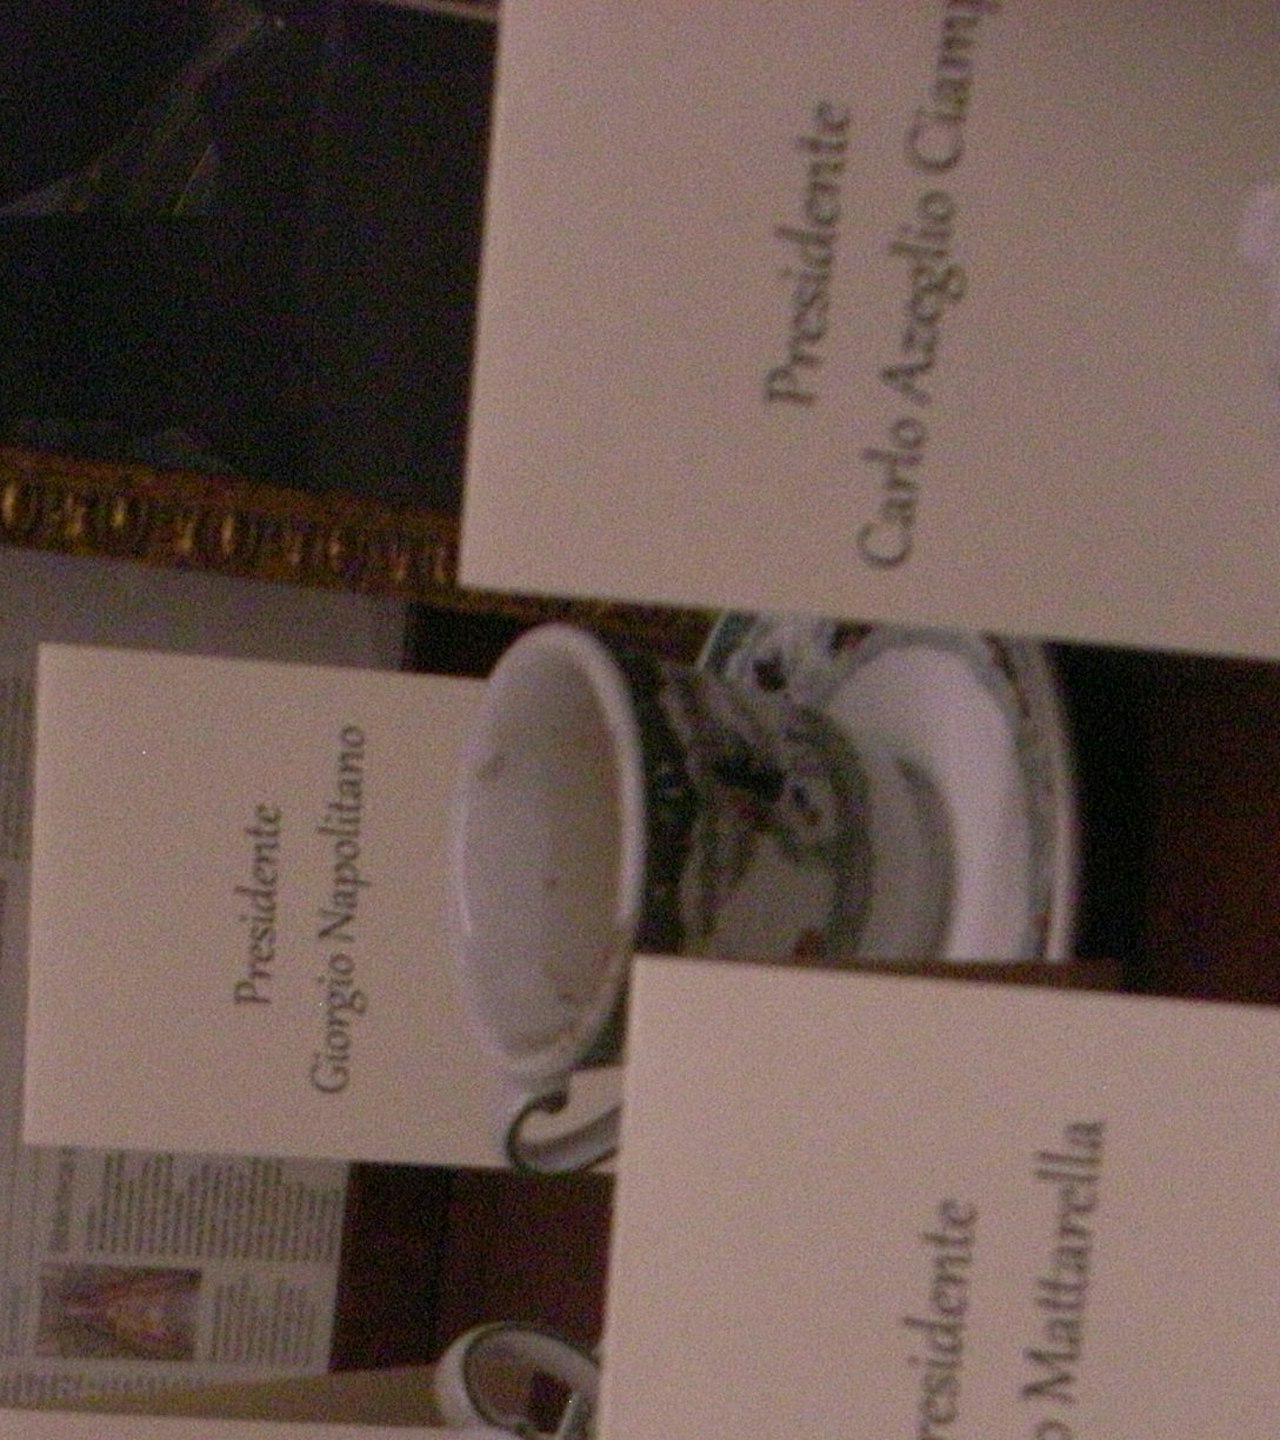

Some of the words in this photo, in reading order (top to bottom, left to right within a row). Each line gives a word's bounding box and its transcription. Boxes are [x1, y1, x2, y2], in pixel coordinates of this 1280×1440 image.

[761, 100, 852, 409] Presidente
[880, 189, 968, 403] Azeglio
[855, 417, 926, 571] Carlo
[233, 803, 283, 1006] Presidente
[316, 723, 372, 945] Napolitano
[309, 953, 368, 1095] Giorgio
[1020, 1120, 1106, 1405] Mattarella
